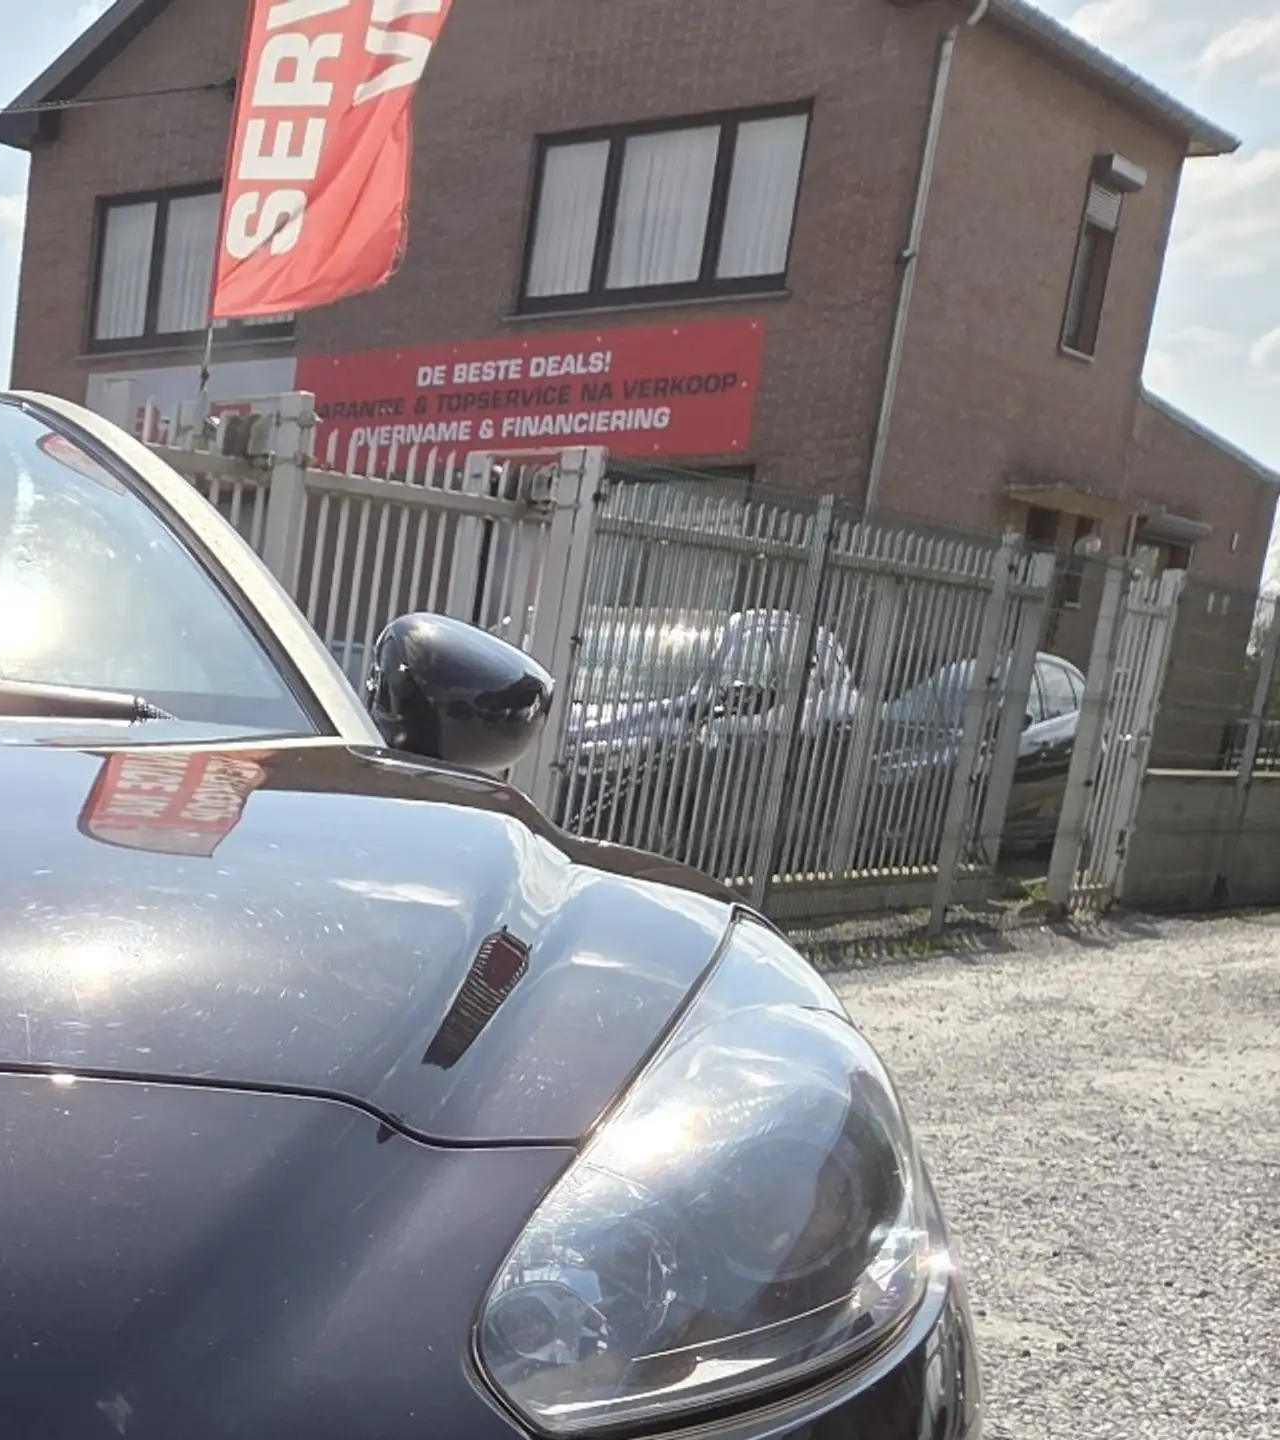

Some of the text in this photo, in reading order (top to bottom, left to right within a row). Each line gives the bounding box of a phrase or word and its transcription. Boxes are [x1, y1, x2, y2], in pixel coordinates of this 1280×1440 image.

[416, 351, 612, 387] DE BESTE DEALS!
[316, 372, 738, 420] ARANTIE & TOPSERVICE NA VERKOOP
[350, 406, 671, 447] OVERNAME & FINANCIERING
